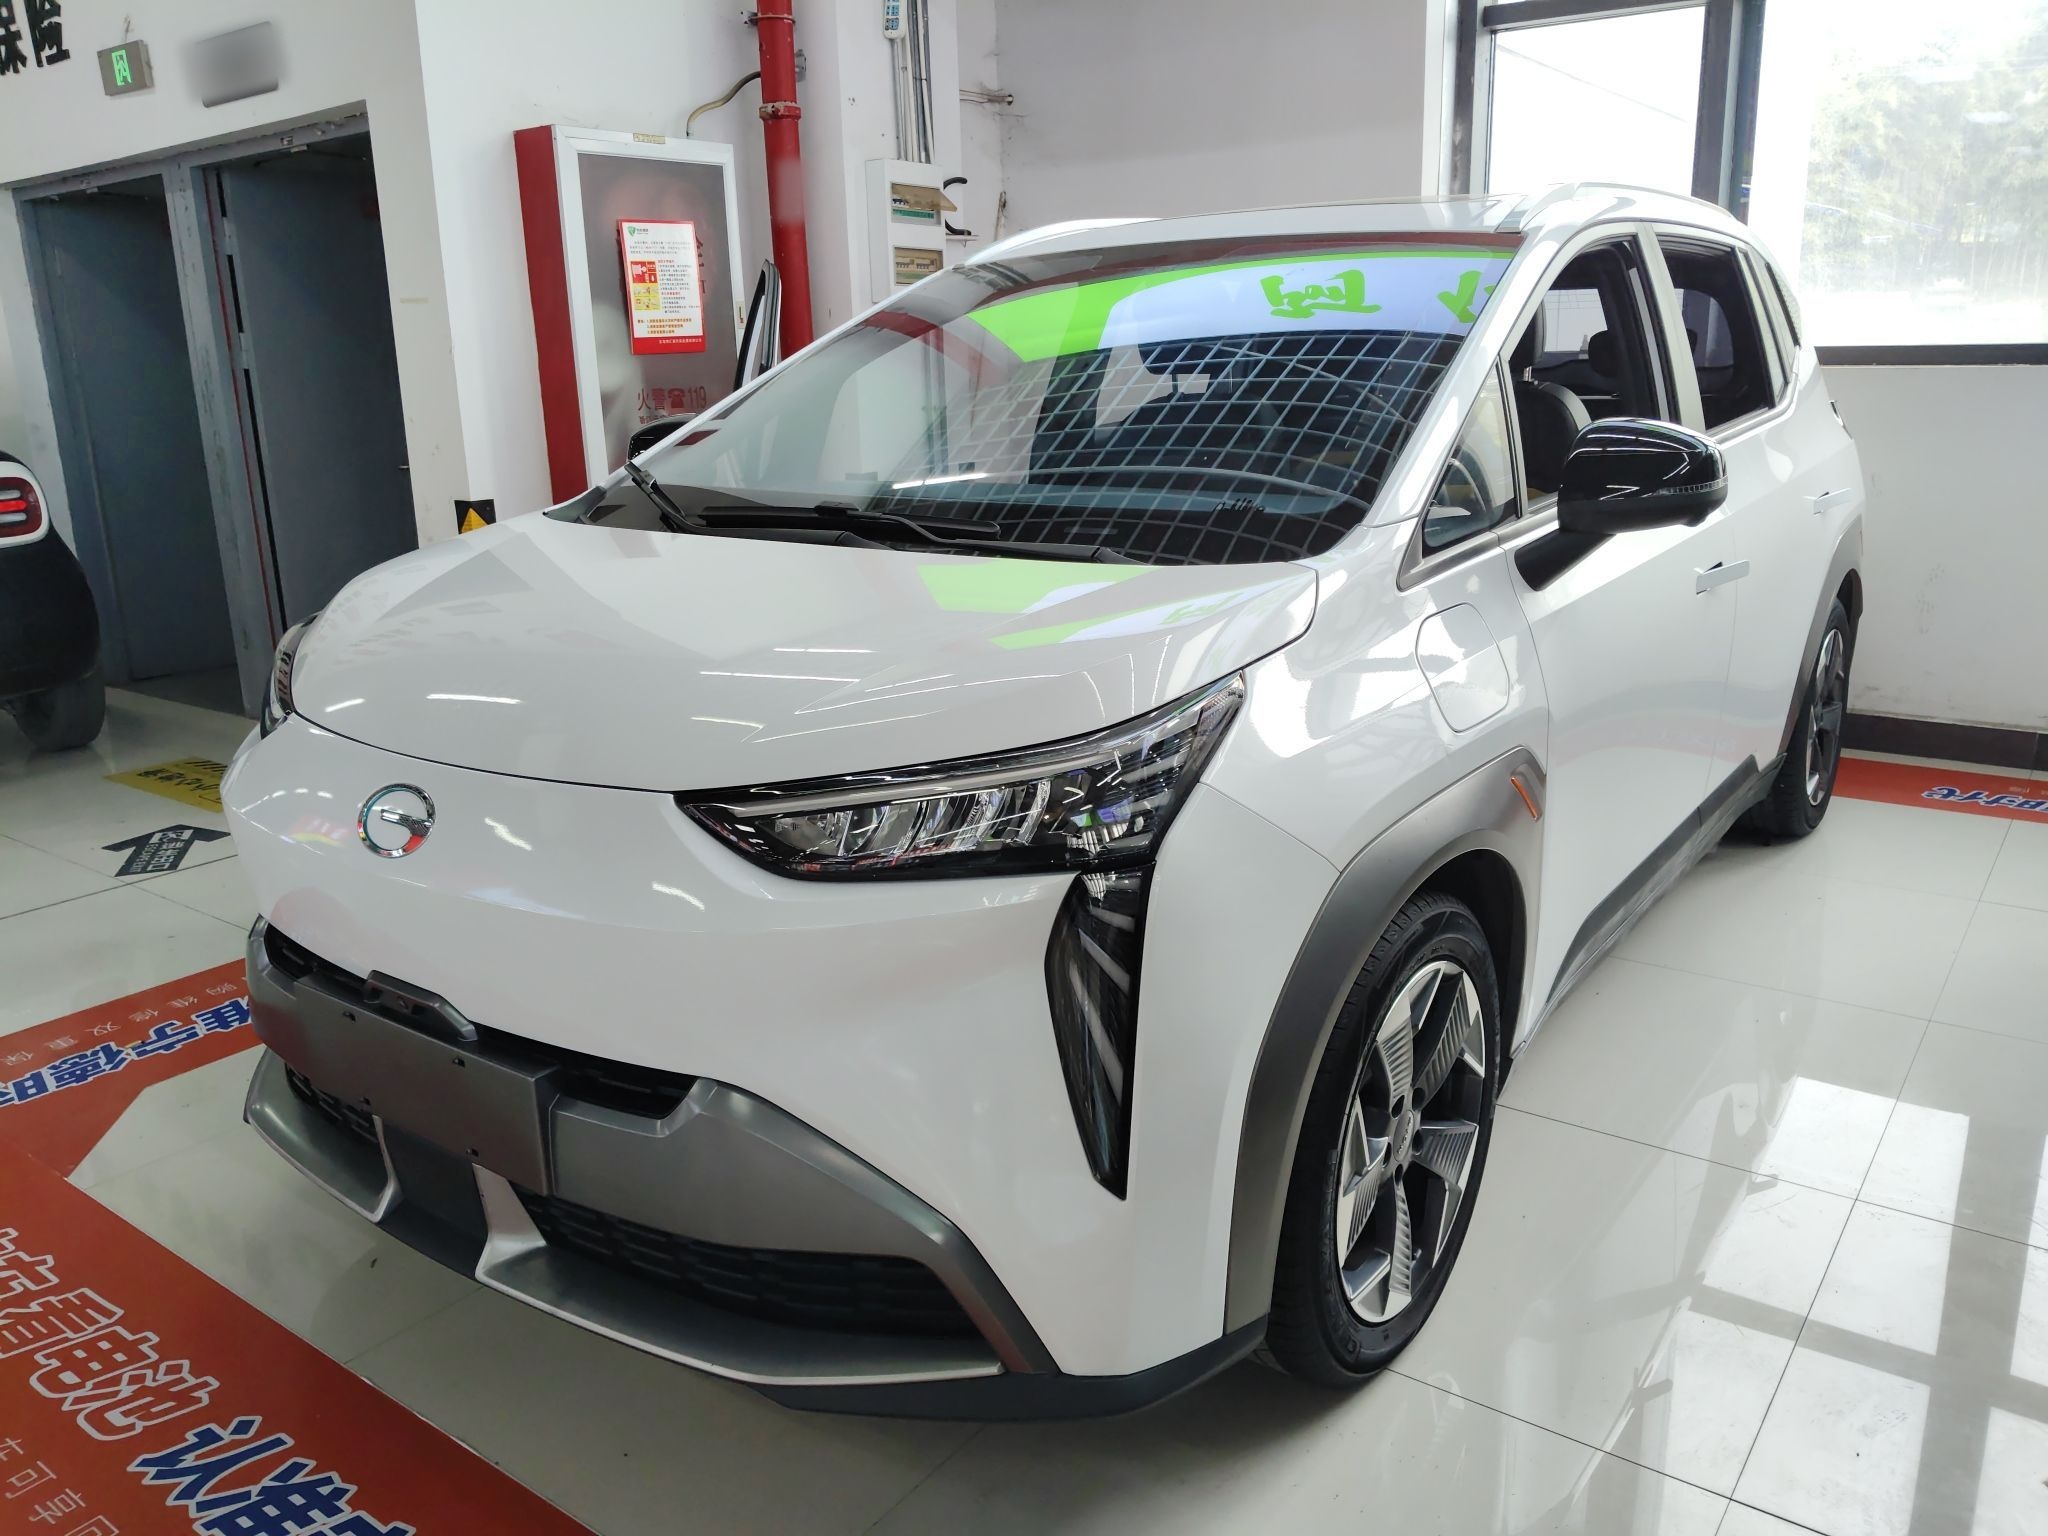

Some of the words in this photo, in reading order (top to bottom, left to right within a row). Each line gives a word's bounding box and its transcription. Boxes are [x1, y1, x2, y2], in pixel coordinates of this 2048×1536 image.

[637, 386, 667, 411] 火警
[687, 385, 707, 411] 119
[1922, 786, 2048, 812] 时代
[1, 978, 246, 1066] 购维修双重保
[127, 1415, 417, 1536] 认准
